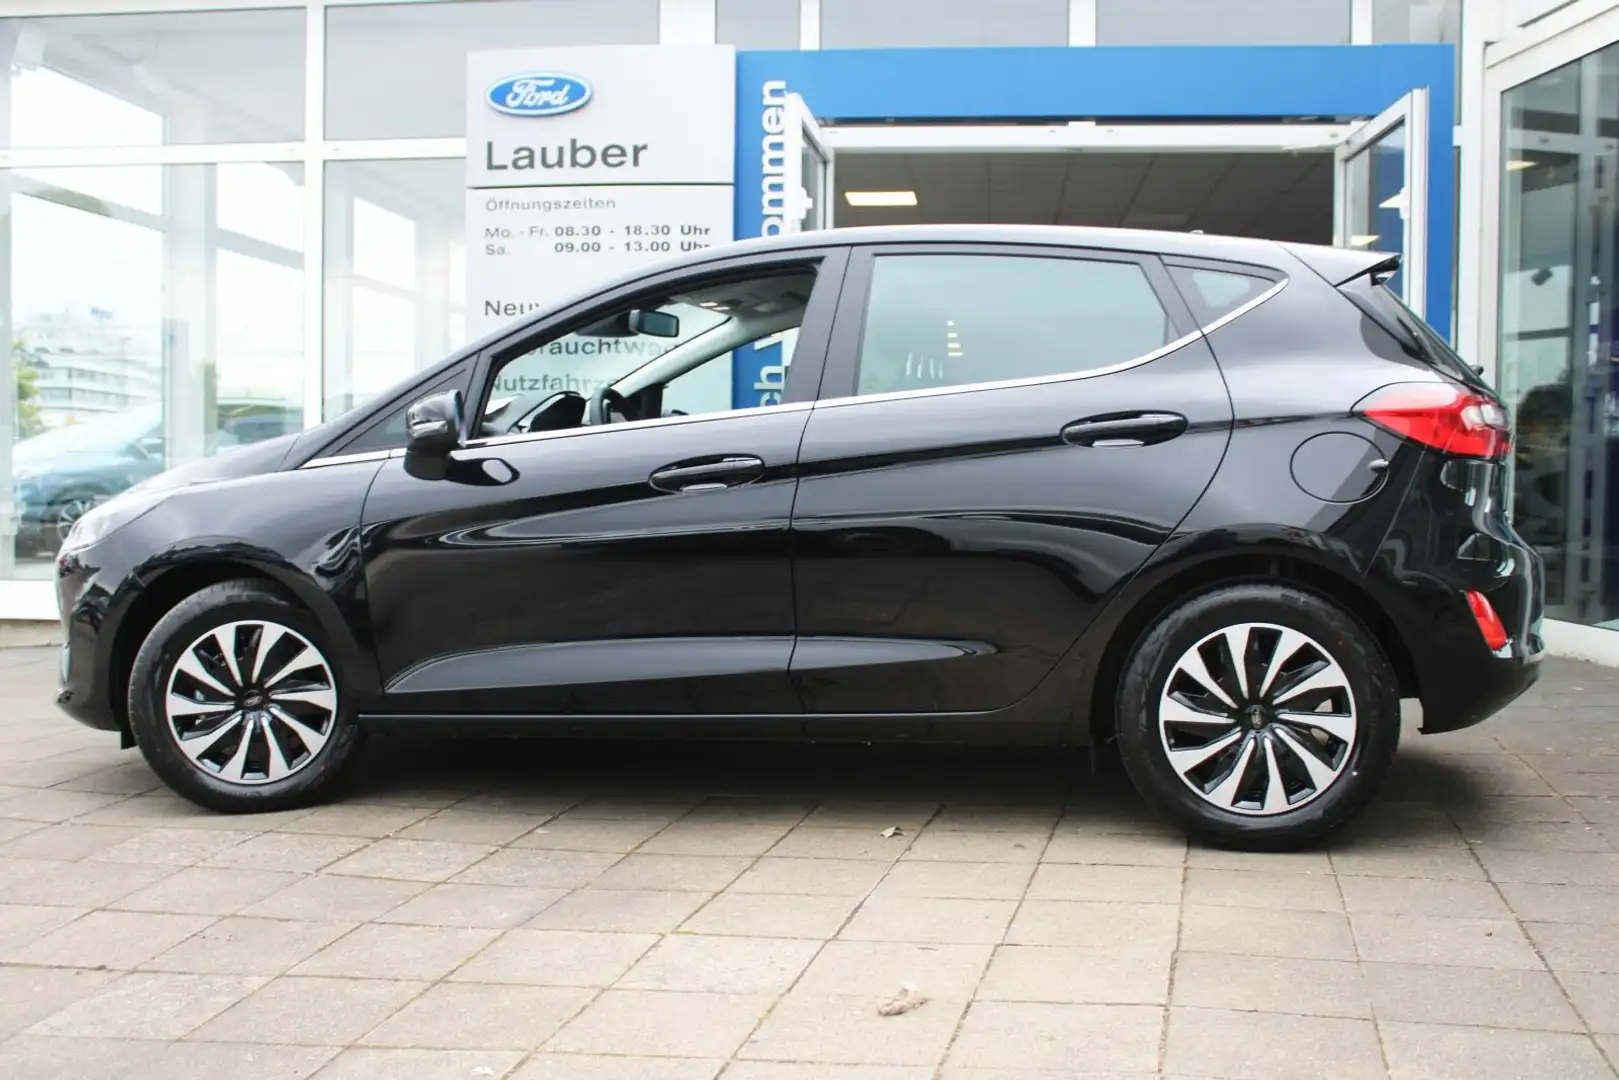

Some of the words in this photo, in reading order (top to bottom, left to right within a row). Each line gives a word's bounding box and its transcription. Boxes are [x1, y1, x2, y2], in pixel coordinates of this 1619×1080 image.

[506, 79, 571, 107] Ford
[486, 138, 648, 170] Lauber
[485, 197, 616, 212] Öffnungszeiten
[485, 227, 515, 239] Mo.
[529, 226, 550, 237] Fr.
[554, 225, 601, 237] 08.30
[624, 224, 671, 236] 18.30
[680, 224, 711, 236] Uhr
[485, 244, 511, 256] Sa.
[554, 242, 601, 253] 09.00
[624, 241, 671, 252] 13.00
[485, 299, 540, 317] Neu
[526, 338, 679, 357] rauchtwa
